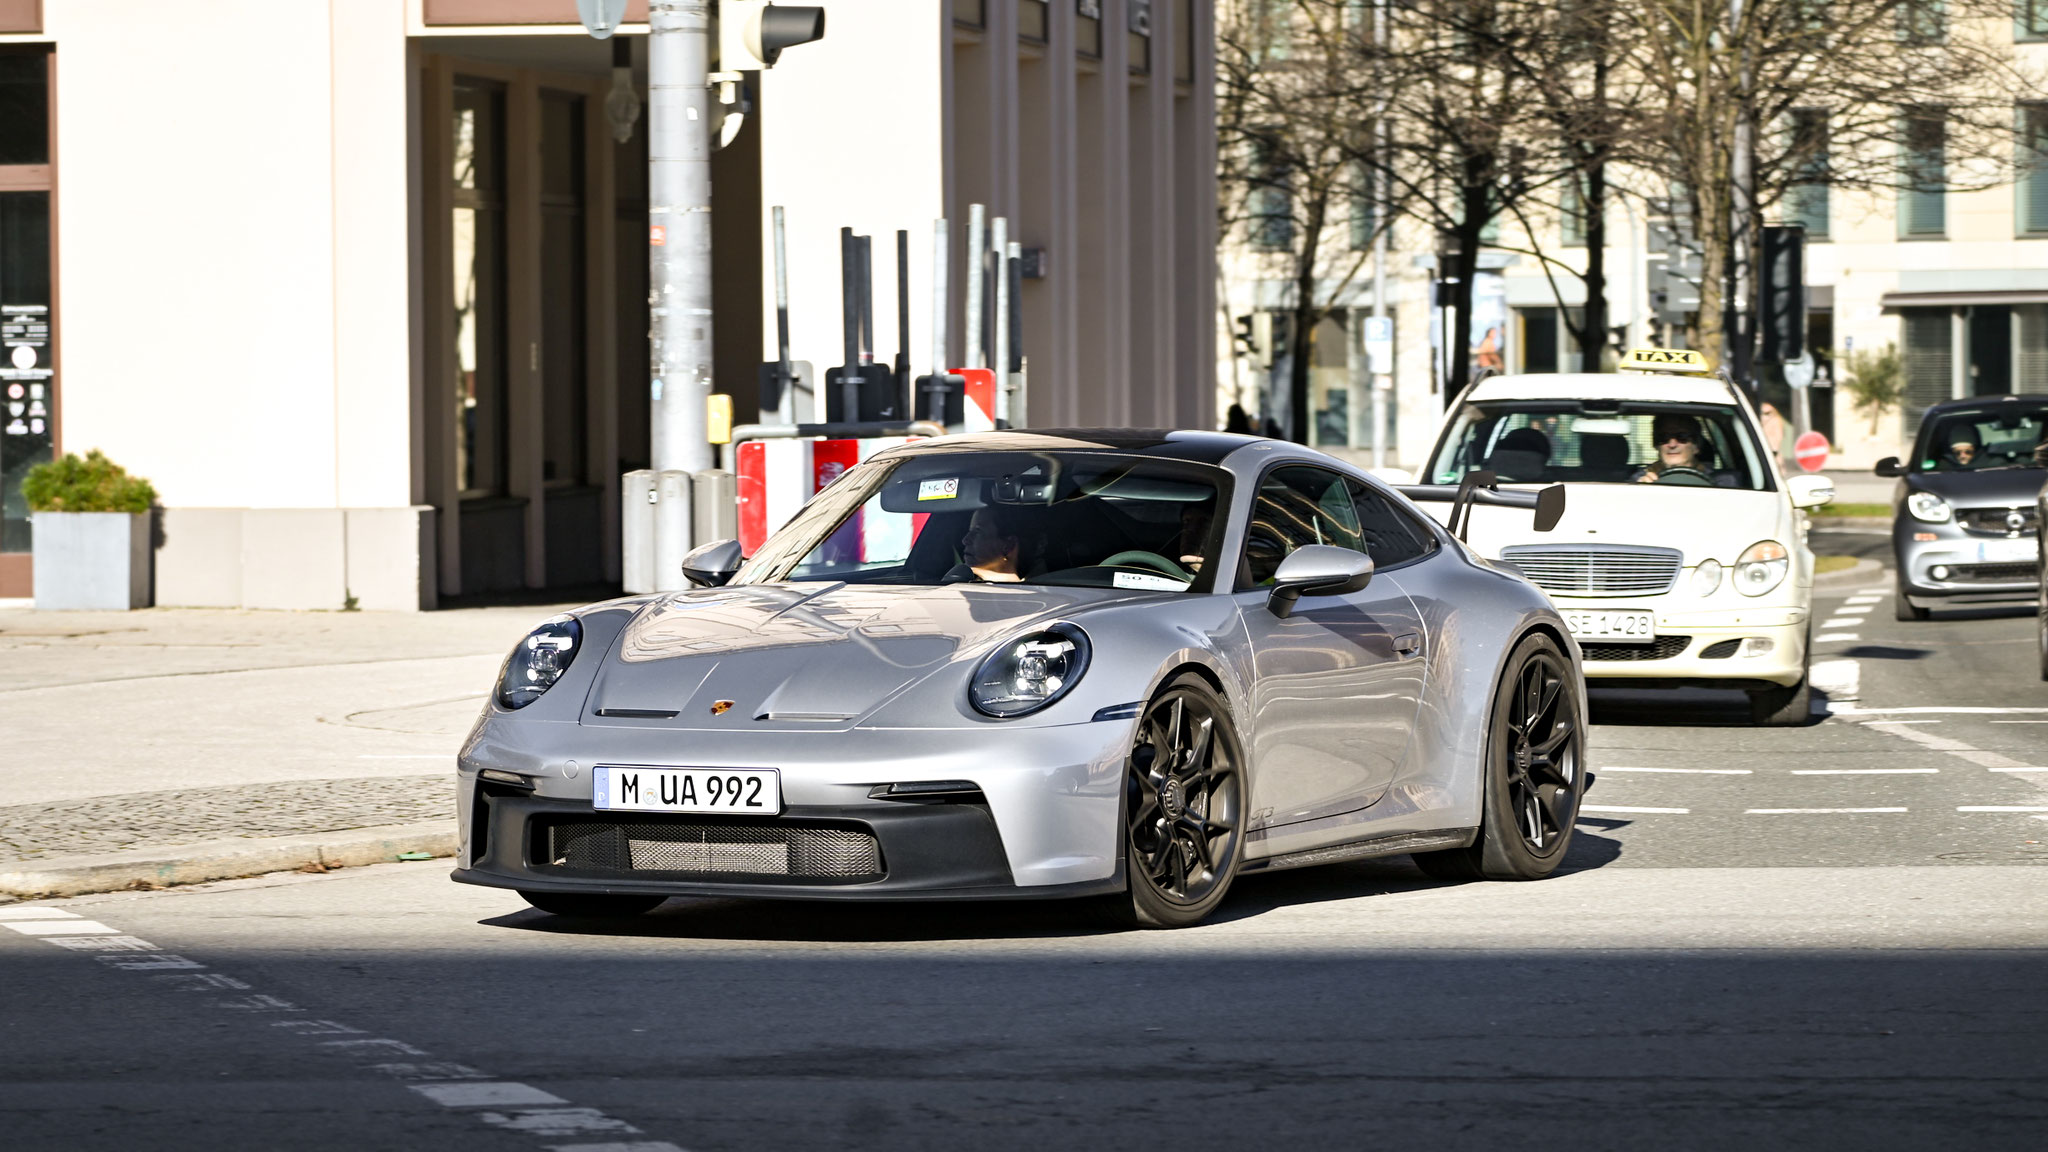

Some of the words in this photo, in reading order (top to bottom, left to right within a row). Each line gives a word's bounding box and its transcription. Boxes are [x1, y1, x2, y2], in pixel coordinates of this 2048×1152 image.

[1636, 351, 1696, 364] TAXI
[1568, 615, 1592, 634] SE
[1600, 615, 1649, 635] 1428
[621, 773, 639, 805] M
[660, 774, 698, 806] UA
[706, 775, 763, 807] 992
